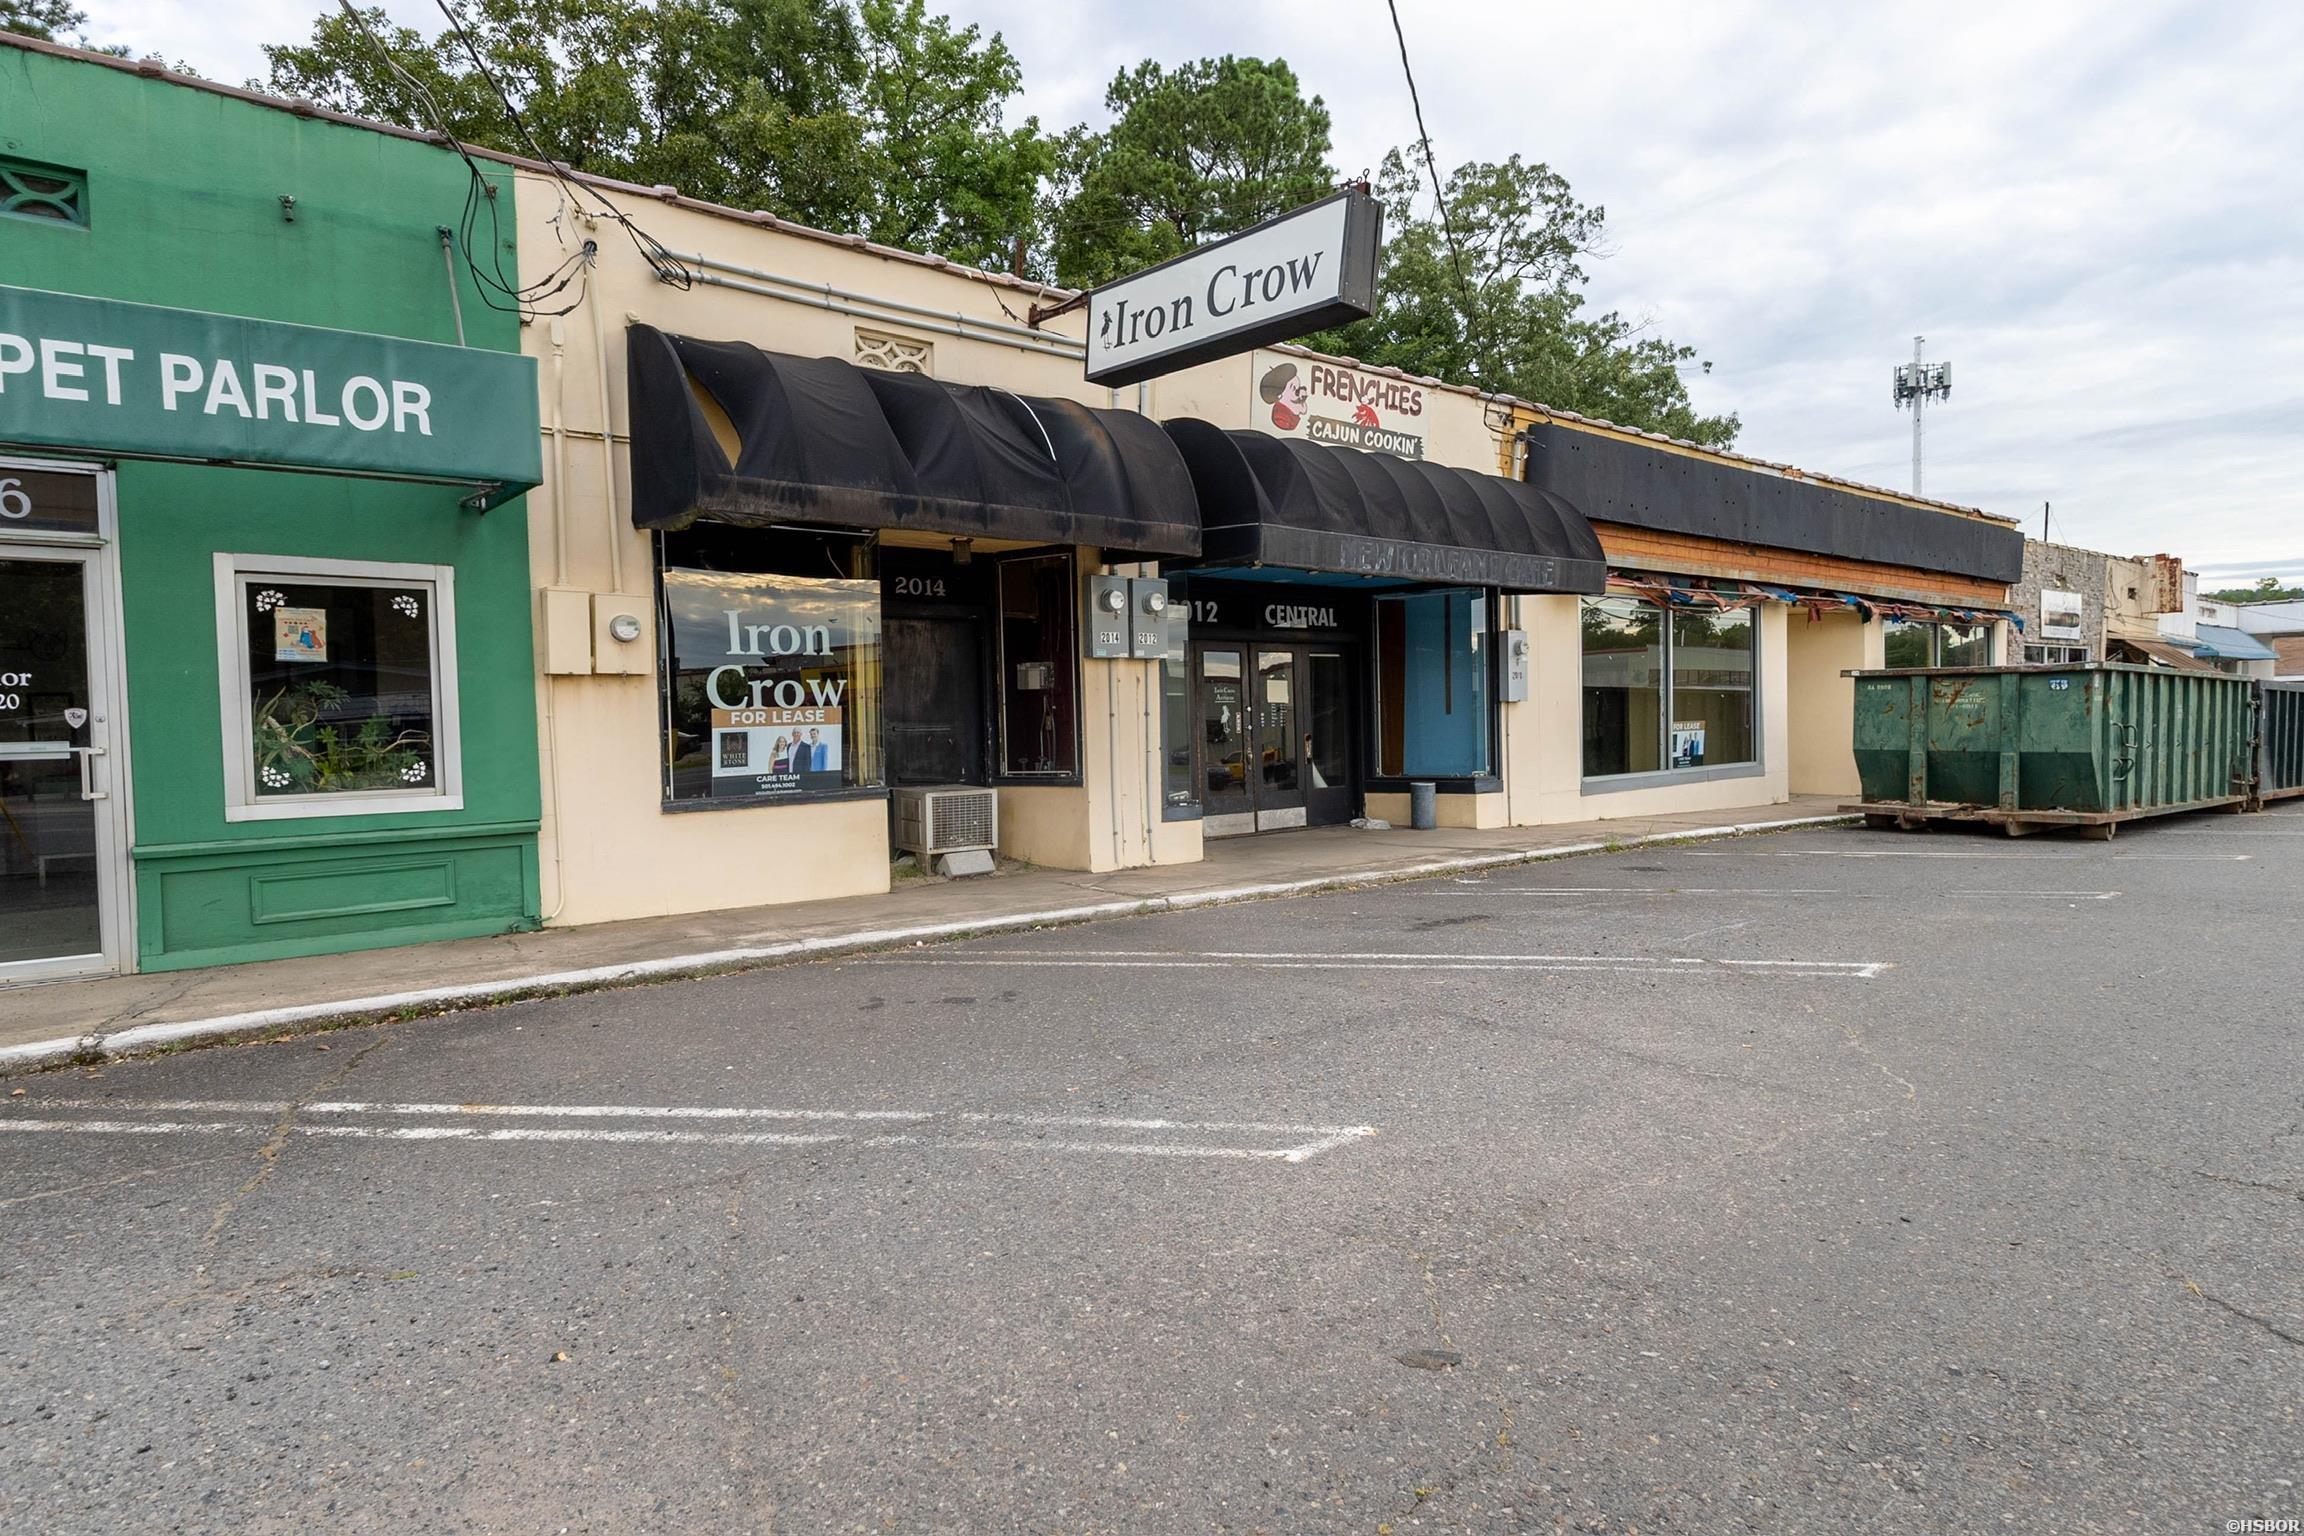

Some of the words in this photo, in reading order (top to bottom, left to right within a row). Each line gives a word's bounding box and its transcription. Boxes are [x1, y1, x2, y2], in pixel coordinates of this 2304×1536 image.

[1113, 296, 1194, 349] Iron
[1206, 251, 1324, 318] Crow
[0, 333, 135, 406] PET
[160, 352, 433, 436] PARLOR
[1310, 365, 1423, 417] FRENCHIES
[1312, 420, 1360, 444] CAJUN
[1364, 430, 1419, 455] COOKIN'
[895, 576, 947, 597] 2014
[1264, 604, 1338, 627] CENTRAL
[723, 609, 835, 656] Iron
[1101, 631, 1121, 644] 2014
[1138, 632, 1158, 645] 2012
[0, 672, 33, 687] or
[706, 664, 848, 711] Crow
[730, 710, 767, 725] FOR
[771, 709, 826, 724] LEASE
[721, 752, 747, 760] WHITE
[756, 775, 778, 783] CARE
[779, 773, 801, 782] TEAM
